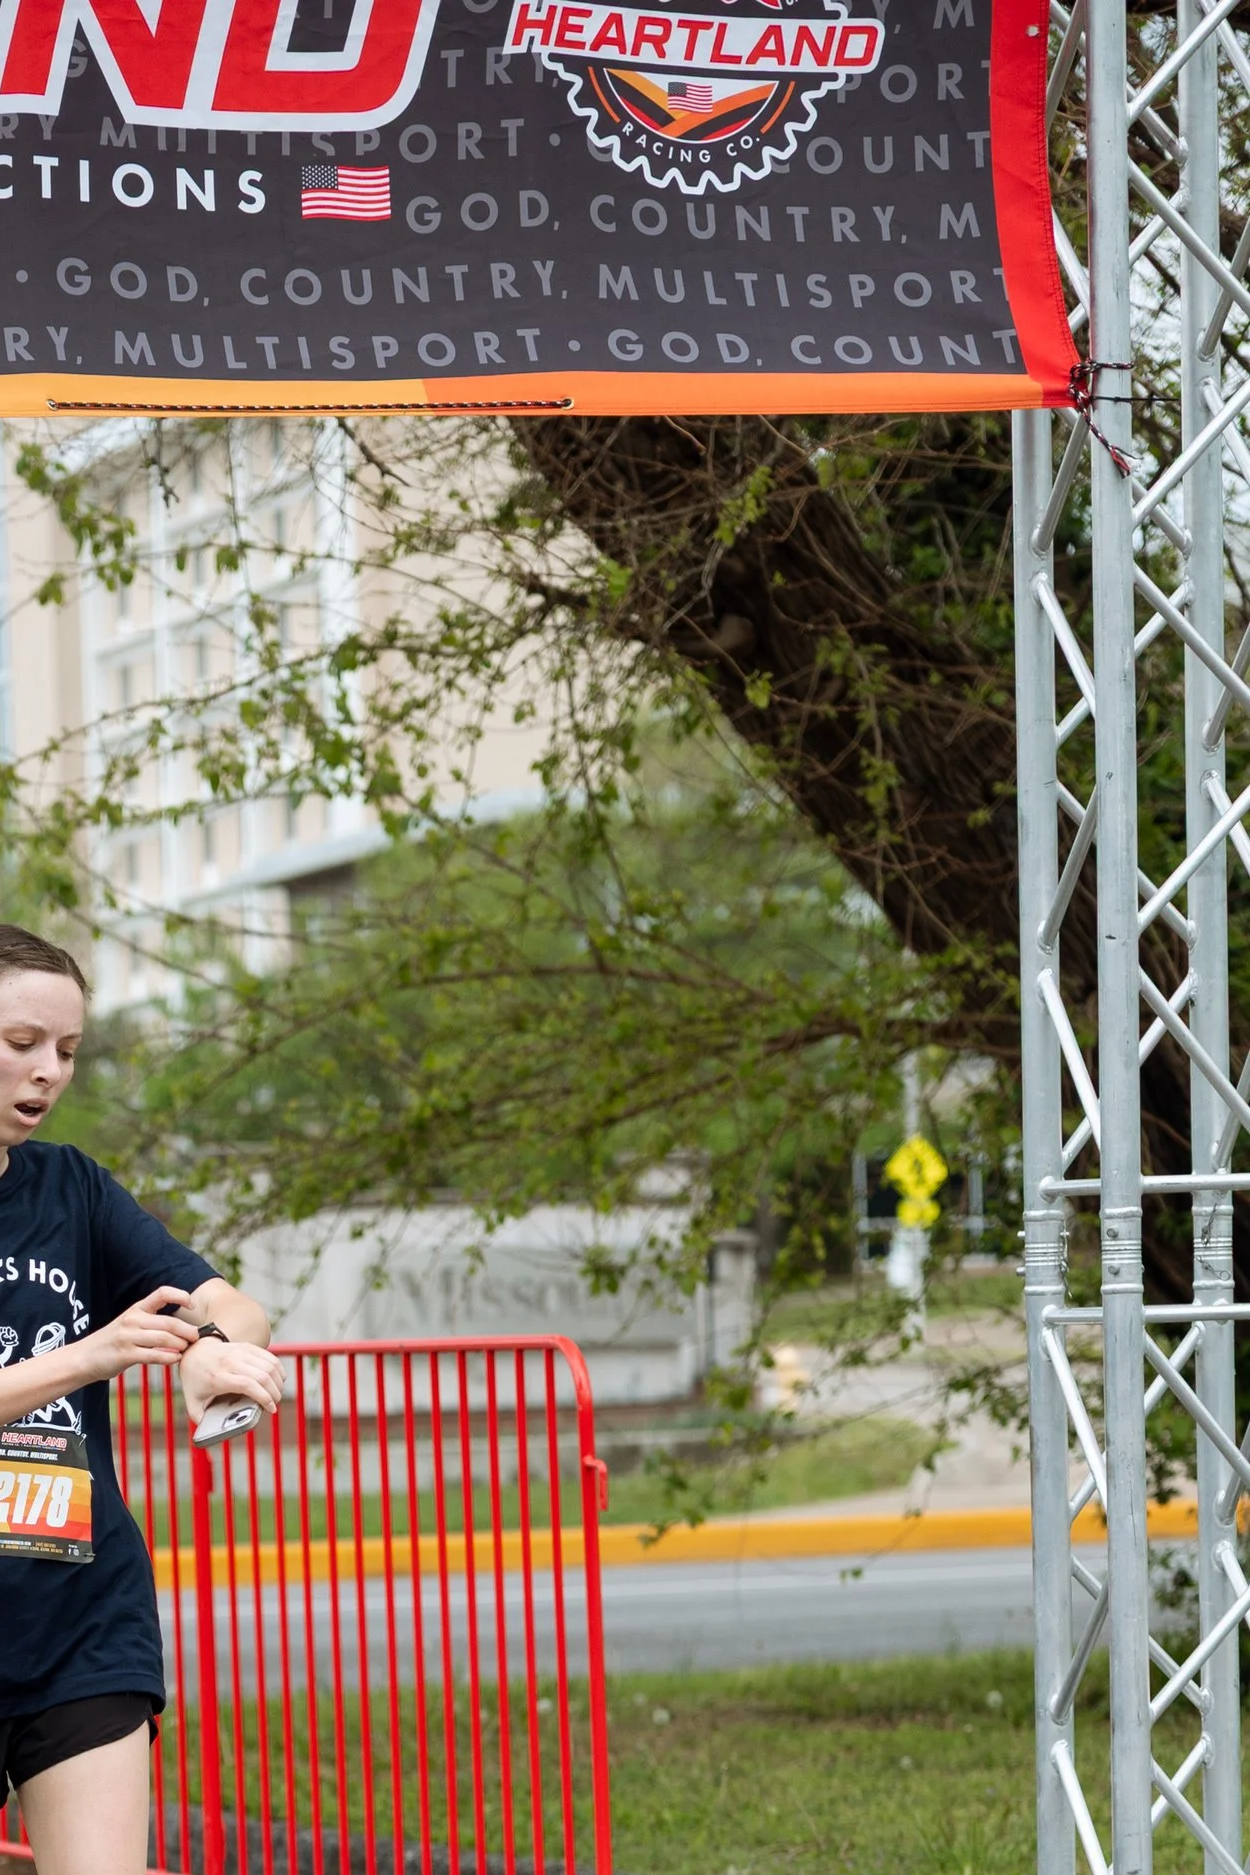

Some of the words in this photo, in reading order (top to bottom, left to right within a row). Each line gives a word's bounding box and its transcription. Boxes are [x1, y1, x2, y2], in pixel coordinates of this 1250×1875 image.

[510, 4, 880, 67] HEARTLAND
[621, 121, 712, 163] RACING
[726, 135, 761, 157] CO.
[405, 190, 561, 233] GOD,
[589, 195, 910, 244] COUNTRY,
[56, 257, 211, 307] GOD,
[240, 259, 569, 307] COUNTRY,
[598, 263, 1014, 310] MULTISPORT
[113, 327, 544, 372] MULTISPORT
[606, 328, 764, 368] GOD,
[28, 1258, 90, 1336] HOUSE
[1, 1431, 68, 1449] HEARTLAND
